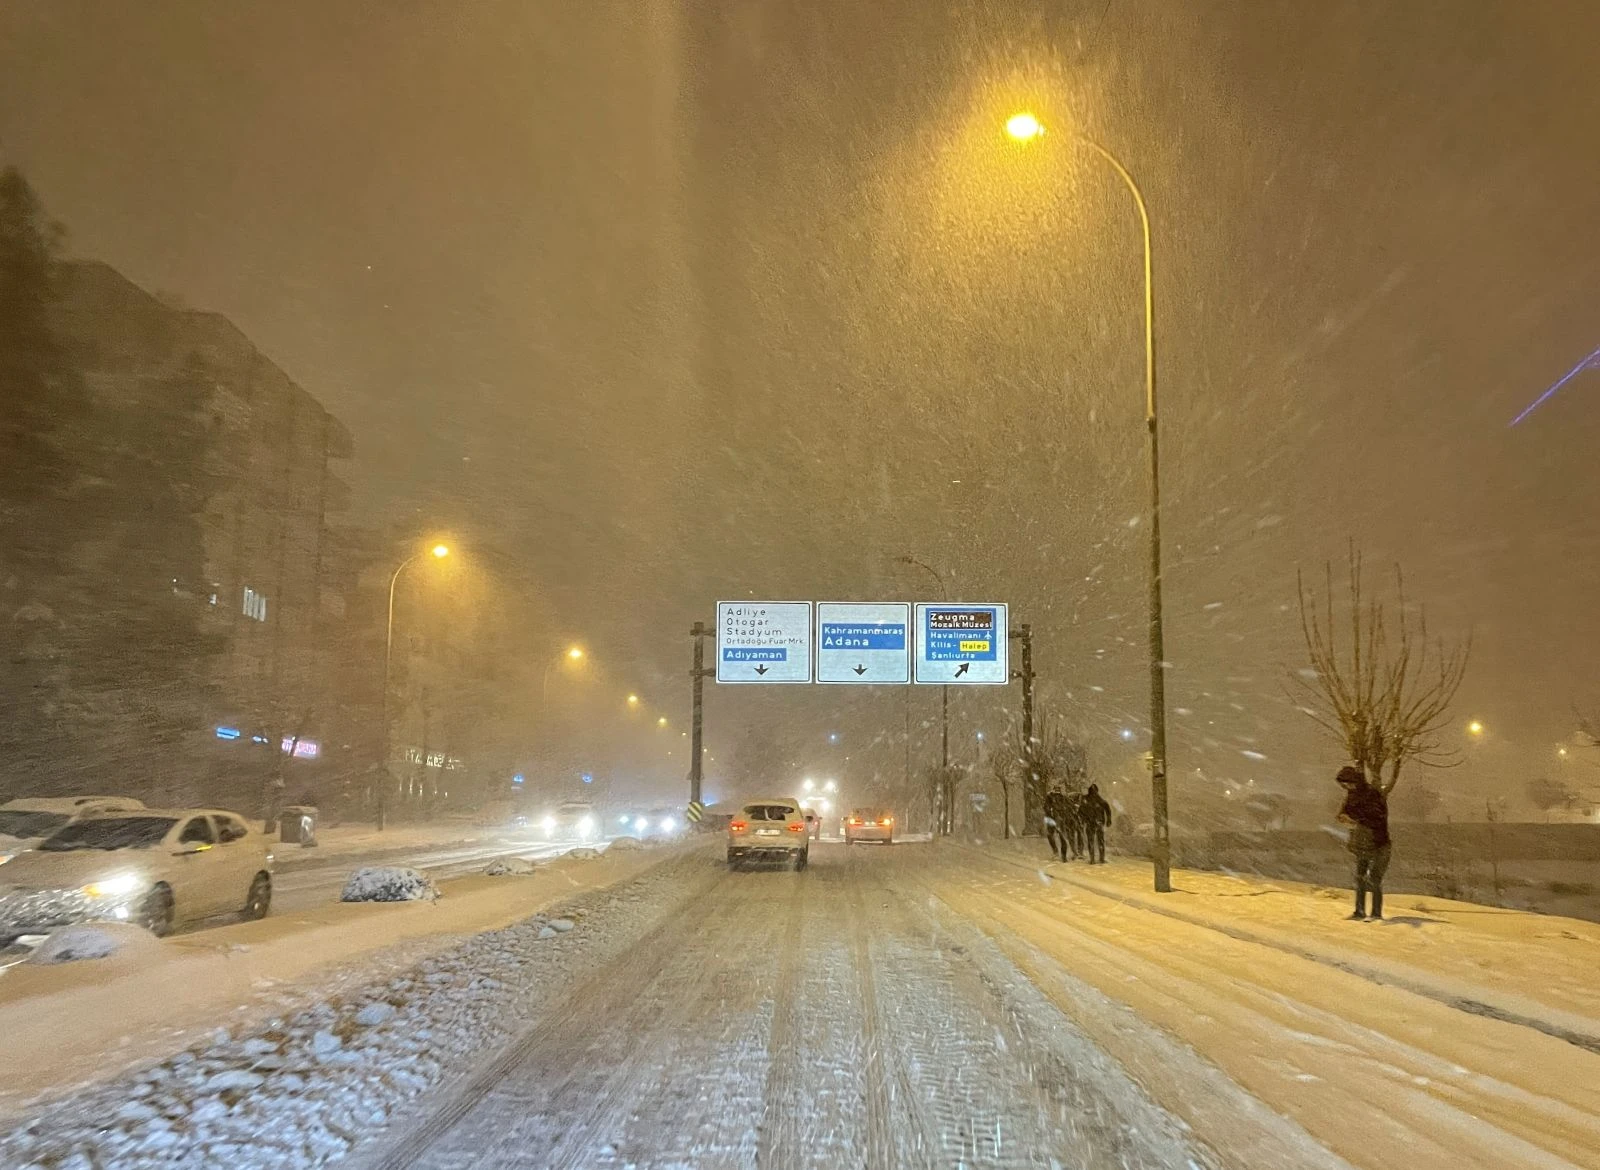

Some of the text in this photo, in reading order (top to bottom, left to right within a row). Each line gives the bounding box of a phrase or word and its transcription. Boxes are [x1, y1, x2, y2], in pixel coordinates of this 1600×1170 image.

[727, 608, 766, 617] Adliye
[930, 613, 975, 622] Zeugma
[727, 618, 769, 627] Otogar
[727, 628, 782, 637] Stadyum
[825, 626, 904, 635] Kahramanmaraş
[824, 637, 869, 646] Adana
[726, 651, 783, 660] Adıyaman
